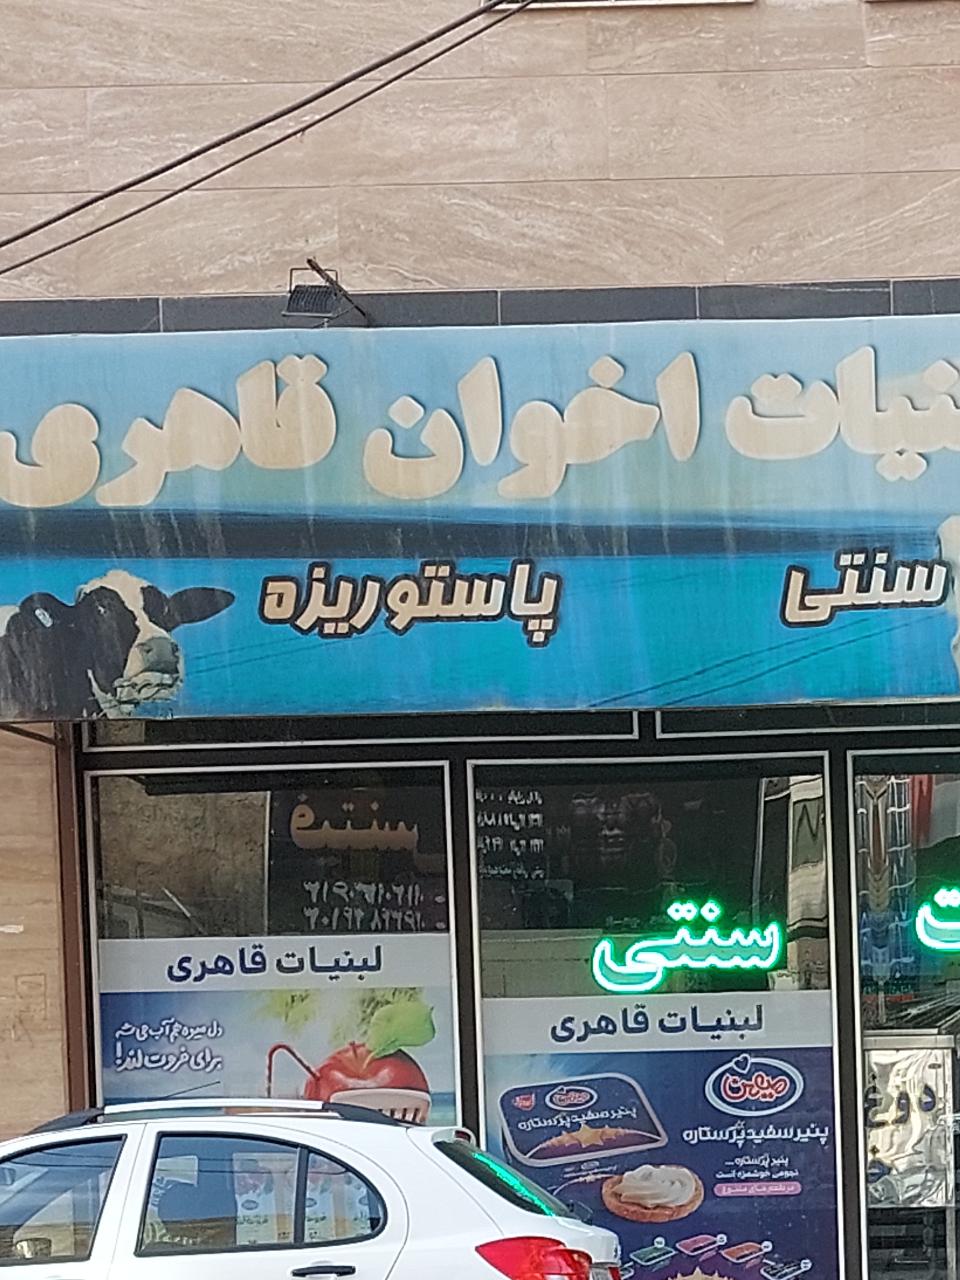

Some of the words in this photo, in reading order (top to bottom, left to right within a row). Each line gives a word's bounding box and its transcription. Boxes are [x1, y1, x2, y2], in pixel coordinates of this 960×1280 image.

[0, 354, 337, 508] قاهری
[363, 351, 702, 499] اخوان
[260, 560, 562, 647] پاستوریزه
[779, 544, 952, 627] سنتی
[166, 944, 267, 983] قاهری
[275, 945, 382, 981] لبنیات
[592, 899, 780, 992] سنتی
[135, 1024, 149, 1041] می
[148, 1016, 175, 1041] آب
[181, 1025, 207, 1041] میوه
[207, 1020, 223, 1038] دل
[550, 1004, 650, 1043] قاهری
[658, 1004, 764, 1040] لبنیات
[143, 1045, 189, 1073] فروت
[189, 1047, 223, 1072] برای
[746, 1123, 794, 1144] سفید
[793, 1122, 830, 1146] پنیر
